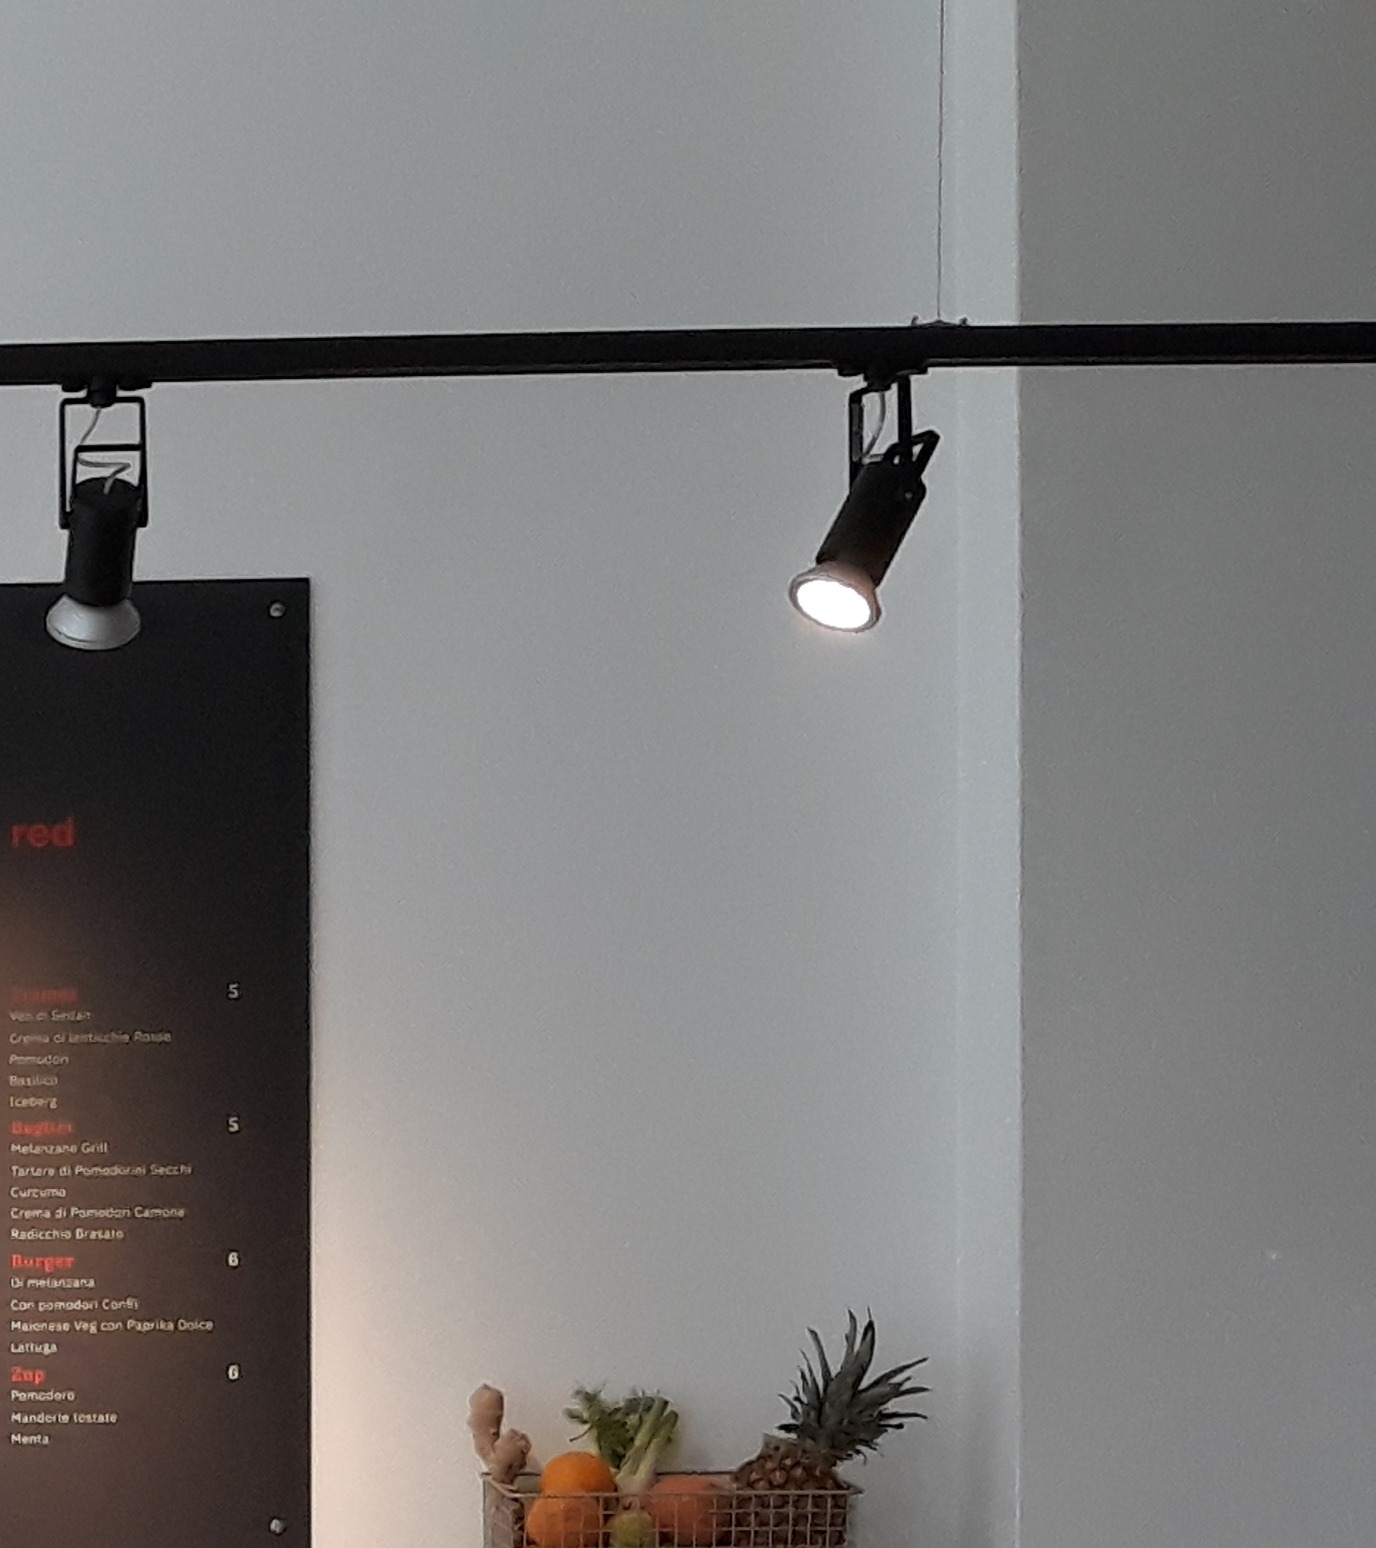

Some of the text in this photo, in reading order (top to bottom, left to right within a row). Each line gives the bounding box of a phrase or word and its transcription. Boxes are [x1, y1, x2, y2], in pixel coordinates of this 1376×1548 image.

[12, 820, 74, 848] red
[228, 983, 239, 999] 5
[228, 1116, 239, 1132] 5
